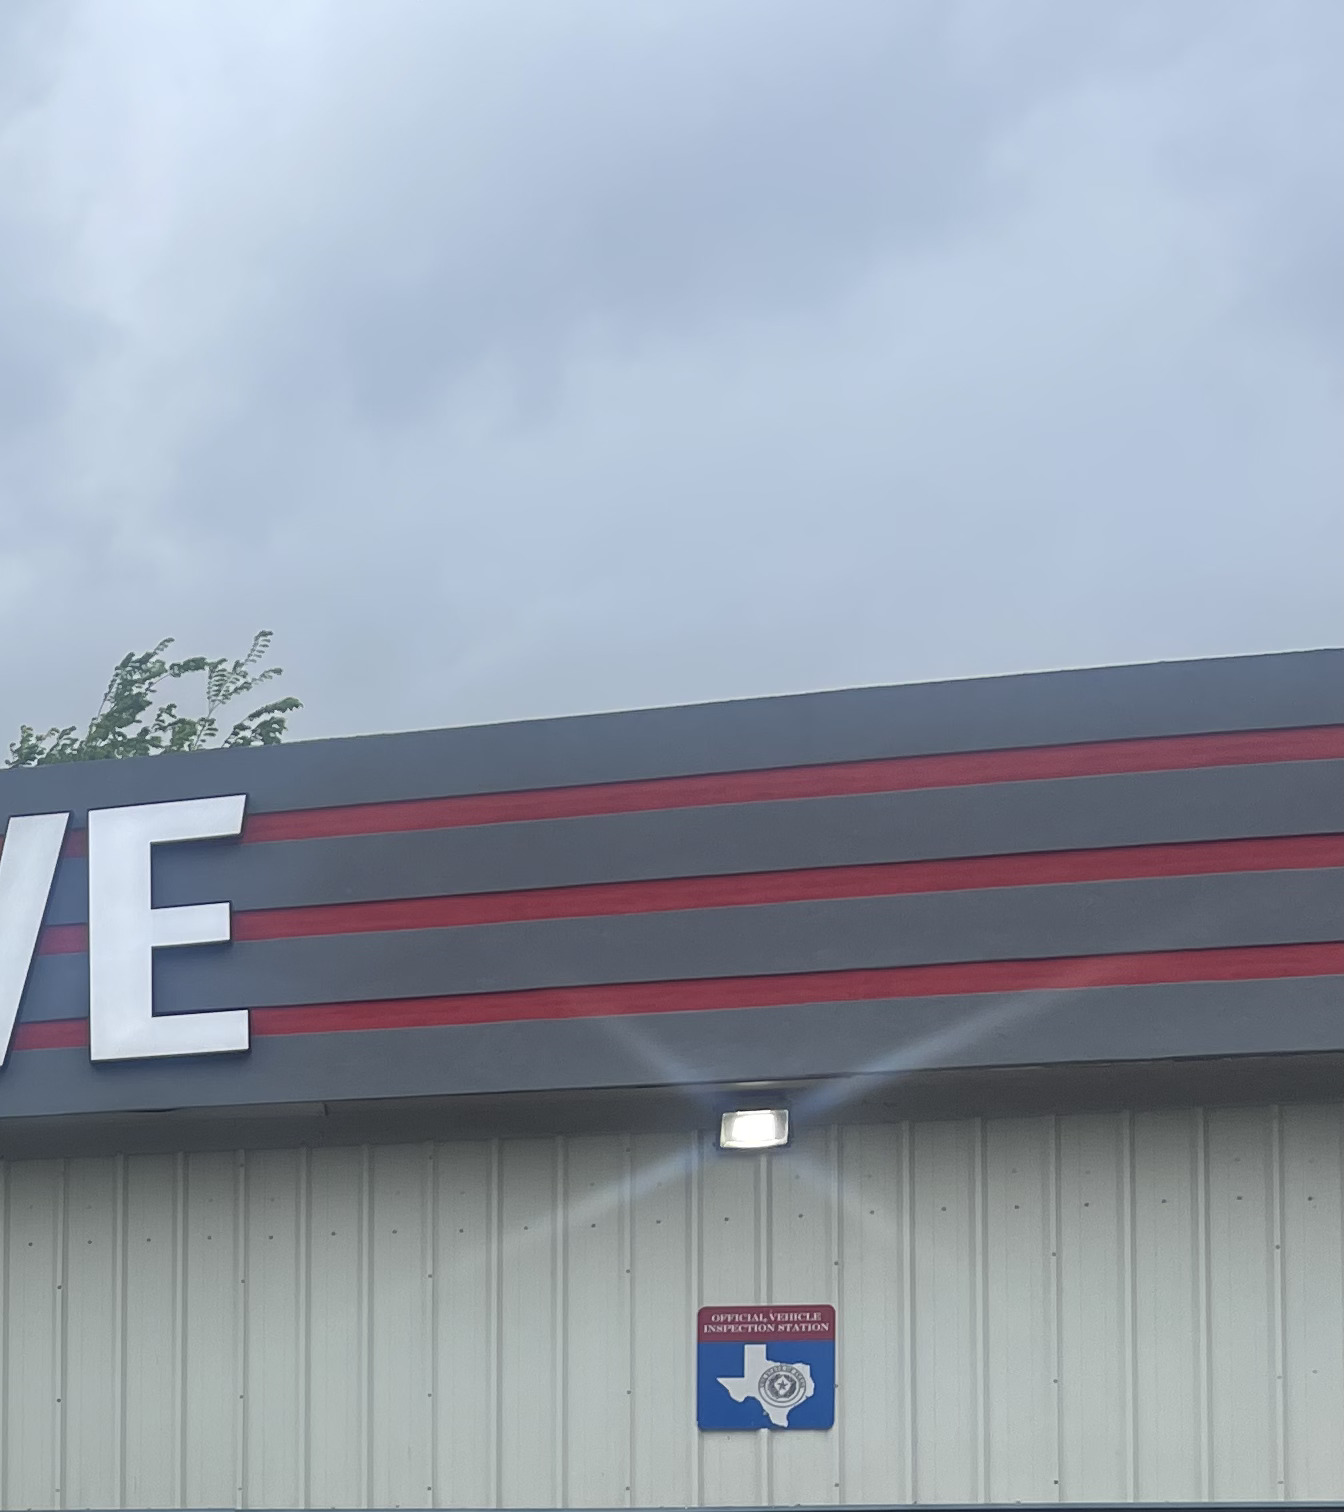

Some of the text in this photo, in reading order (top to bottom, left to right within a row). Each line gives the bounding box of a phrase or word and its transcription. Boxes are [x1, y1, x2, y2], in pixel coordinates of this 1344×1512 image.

[711, 1312, 822, 1322] OFFICIAL VEHICLE
[703, 1323, 829, 1333] INSPECTION STATION
